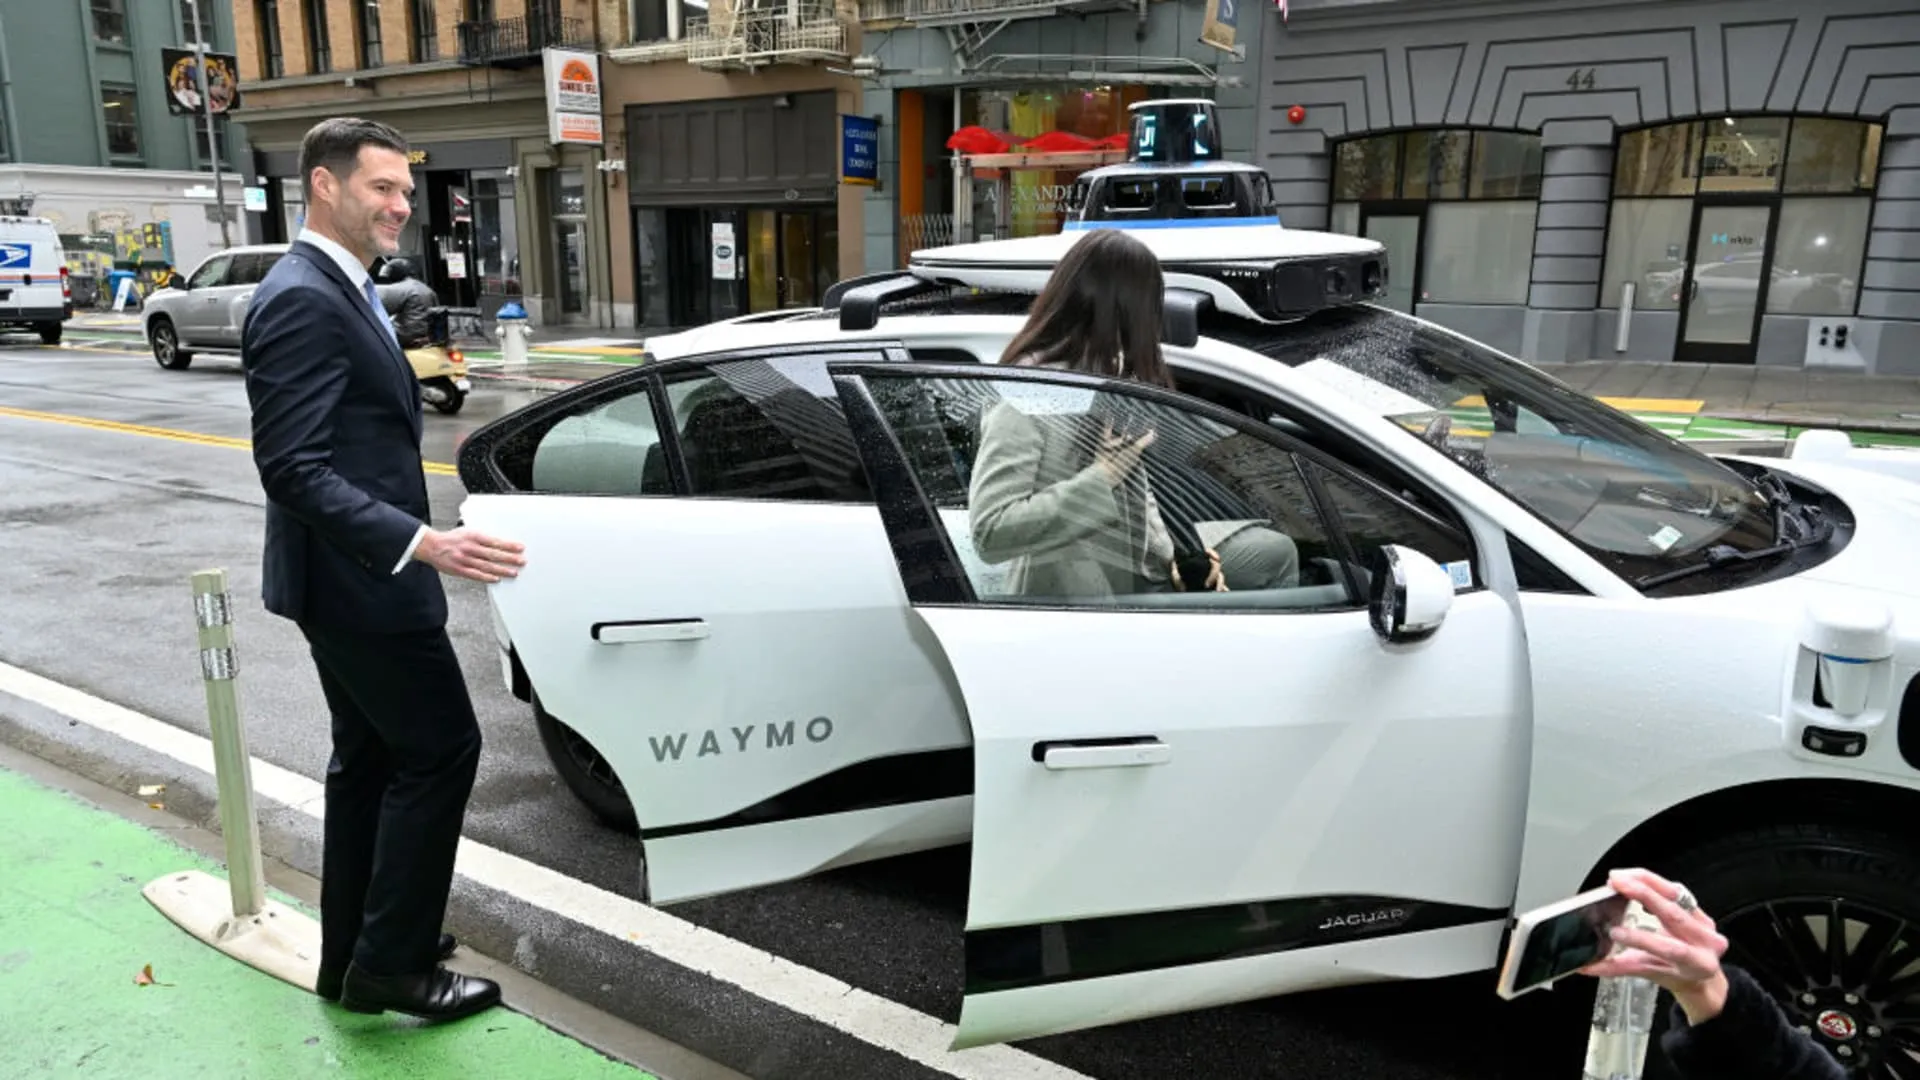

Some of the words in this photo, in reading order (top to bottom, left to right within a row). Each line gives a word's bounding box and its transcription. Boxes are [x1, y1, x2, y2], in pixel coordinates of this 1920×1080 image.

[1565, 68, 1597, 90] 44
[1222, 269, 1259, 278] WAYMO
[648, 715, 834, 763] WAYMO
[1318, 908, 1404, 929] JAGUAR
